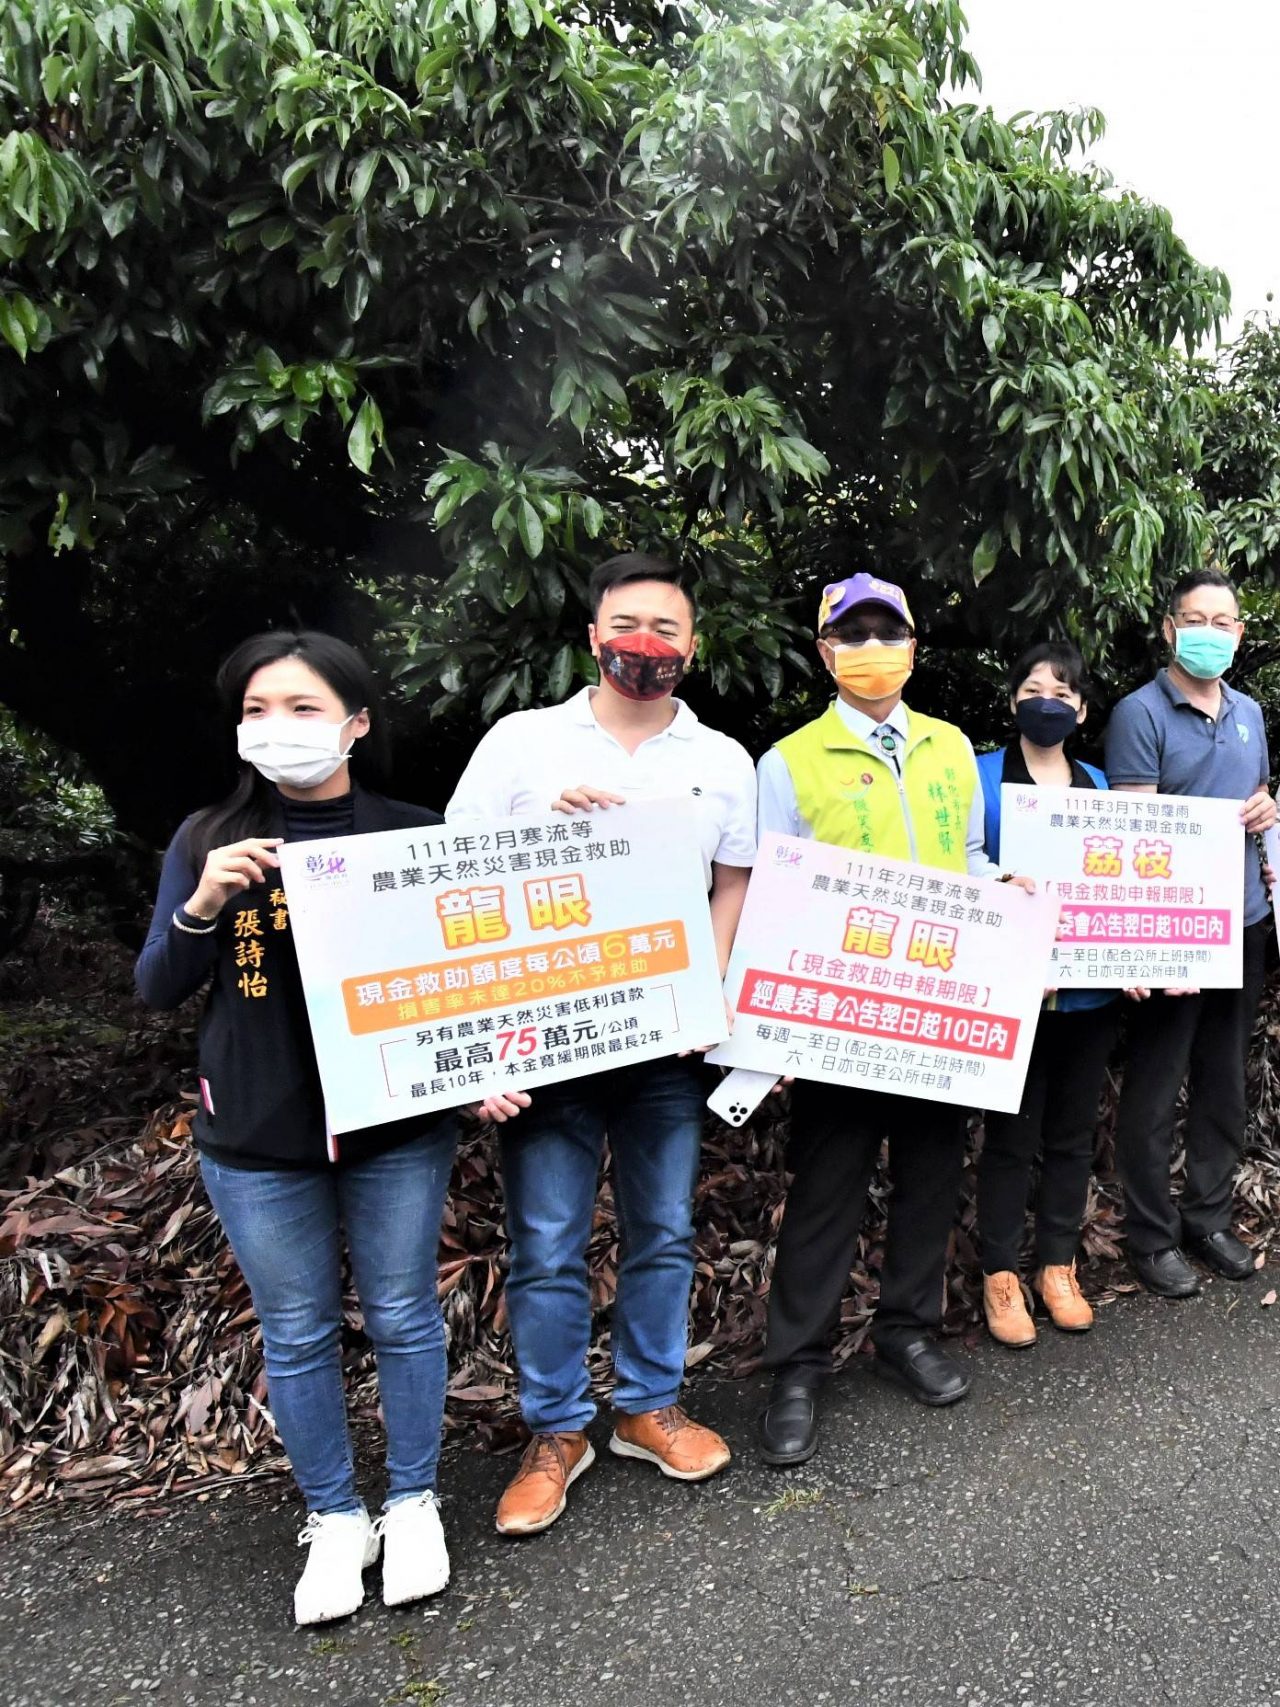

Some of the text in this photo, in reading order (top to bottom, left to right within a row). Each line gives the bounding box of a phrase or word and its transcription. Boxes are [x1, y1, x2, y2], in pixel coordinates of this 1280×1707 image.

[407, 820, 593, 861] 111年2月寒流等
[1050, 813, 1202, 836] 農業天然災害現金救助
[372, 839, 631, 892] 農業天然災害現金救助
[847, 861, 981, 903] 111年2月寒流等
[1083, 835, 1172, 879] 荔枝
[436, 873, 592, 950] 龍眼
[811, 874, 1003, 928] 農業天然災害現金救助
[234, 909, 268, 998] 張詩怡
[841, 906, 958, 972] 龍眼
[355, 929, 676, 1007] 現金救助額度每公頃6萬元
[397, 959, 648, 1020] 損害率未達20%不予救助
[788, 950, 991, 1007] 【現金救助申報期限】
[415, 987, 645, 1046] 另有農業天然災害低利貸款
[434, 1015, 638, 1073] 最高75萬元/公頃
[750, 979, 1009, 1052] 經農委會公告翌日起10日內
[755, 1023, 986, 1077] 每週一至日(配合公所上班時間)
[785, 1049, 951, 1090] 六、日亦可至公所申請
